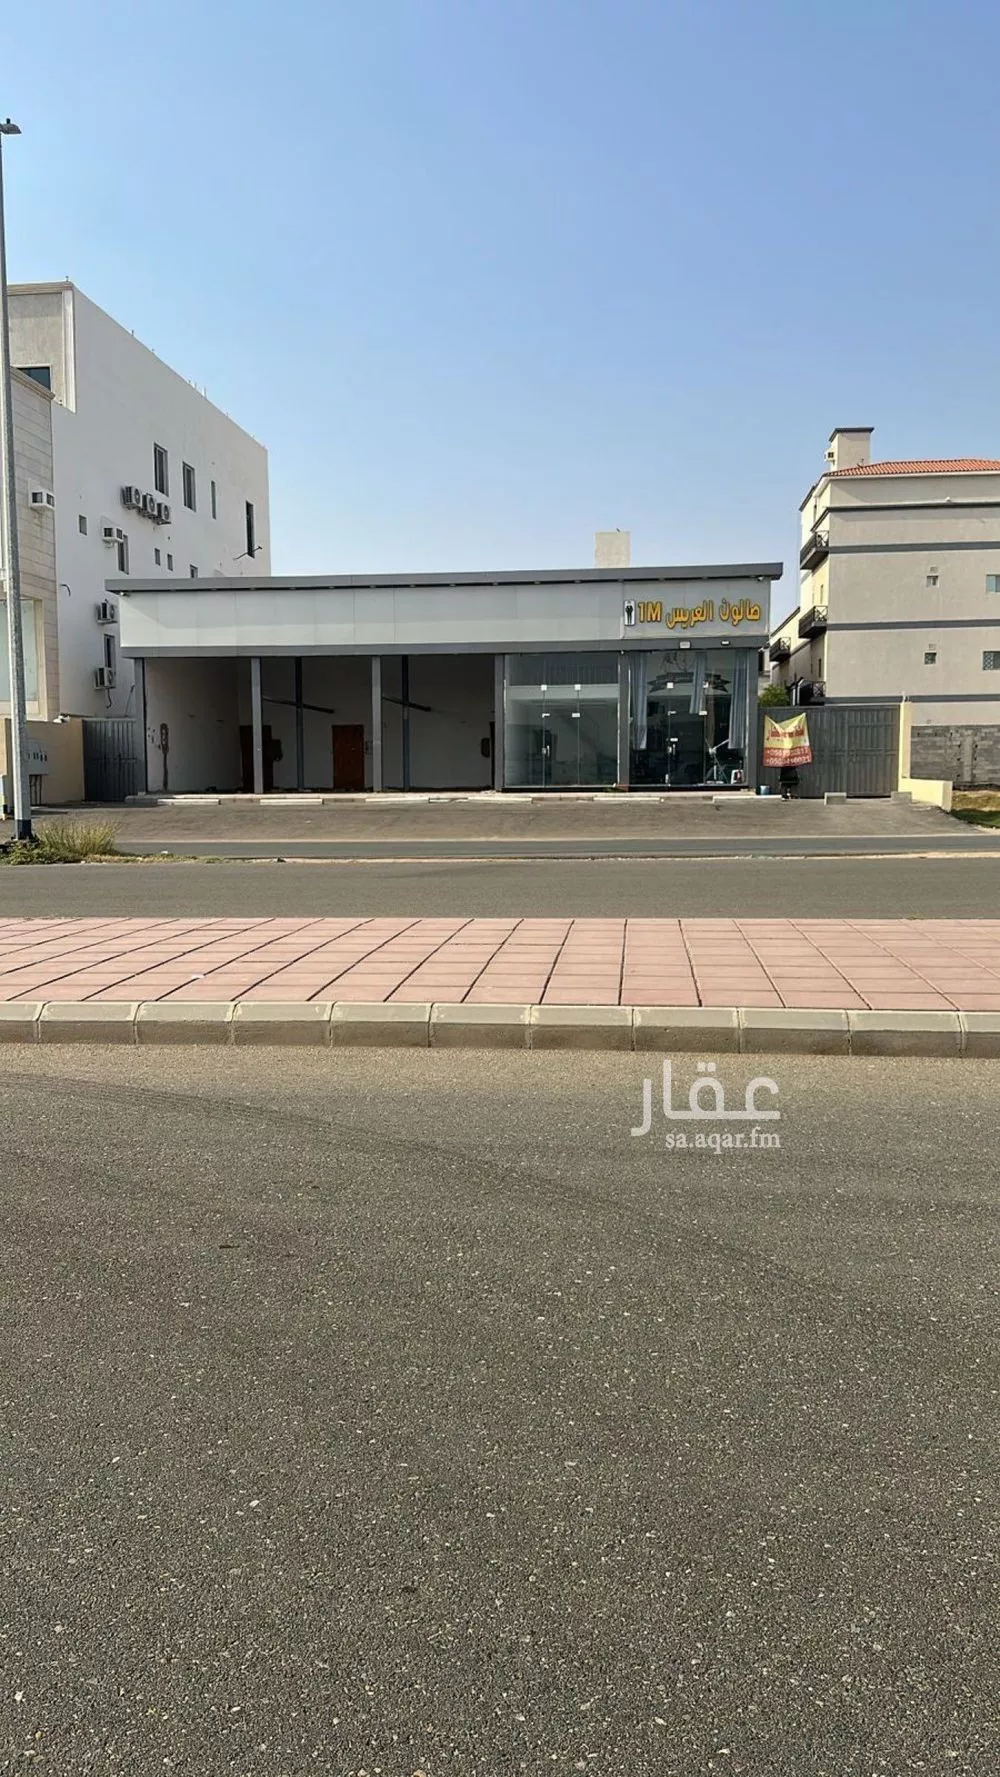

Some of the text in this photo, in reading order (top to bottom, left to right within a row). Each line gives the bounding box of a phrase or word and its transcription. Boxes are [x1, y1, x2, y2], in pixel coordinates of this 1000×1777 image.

[638, 598, 761, 629] صالون العريس 1M
